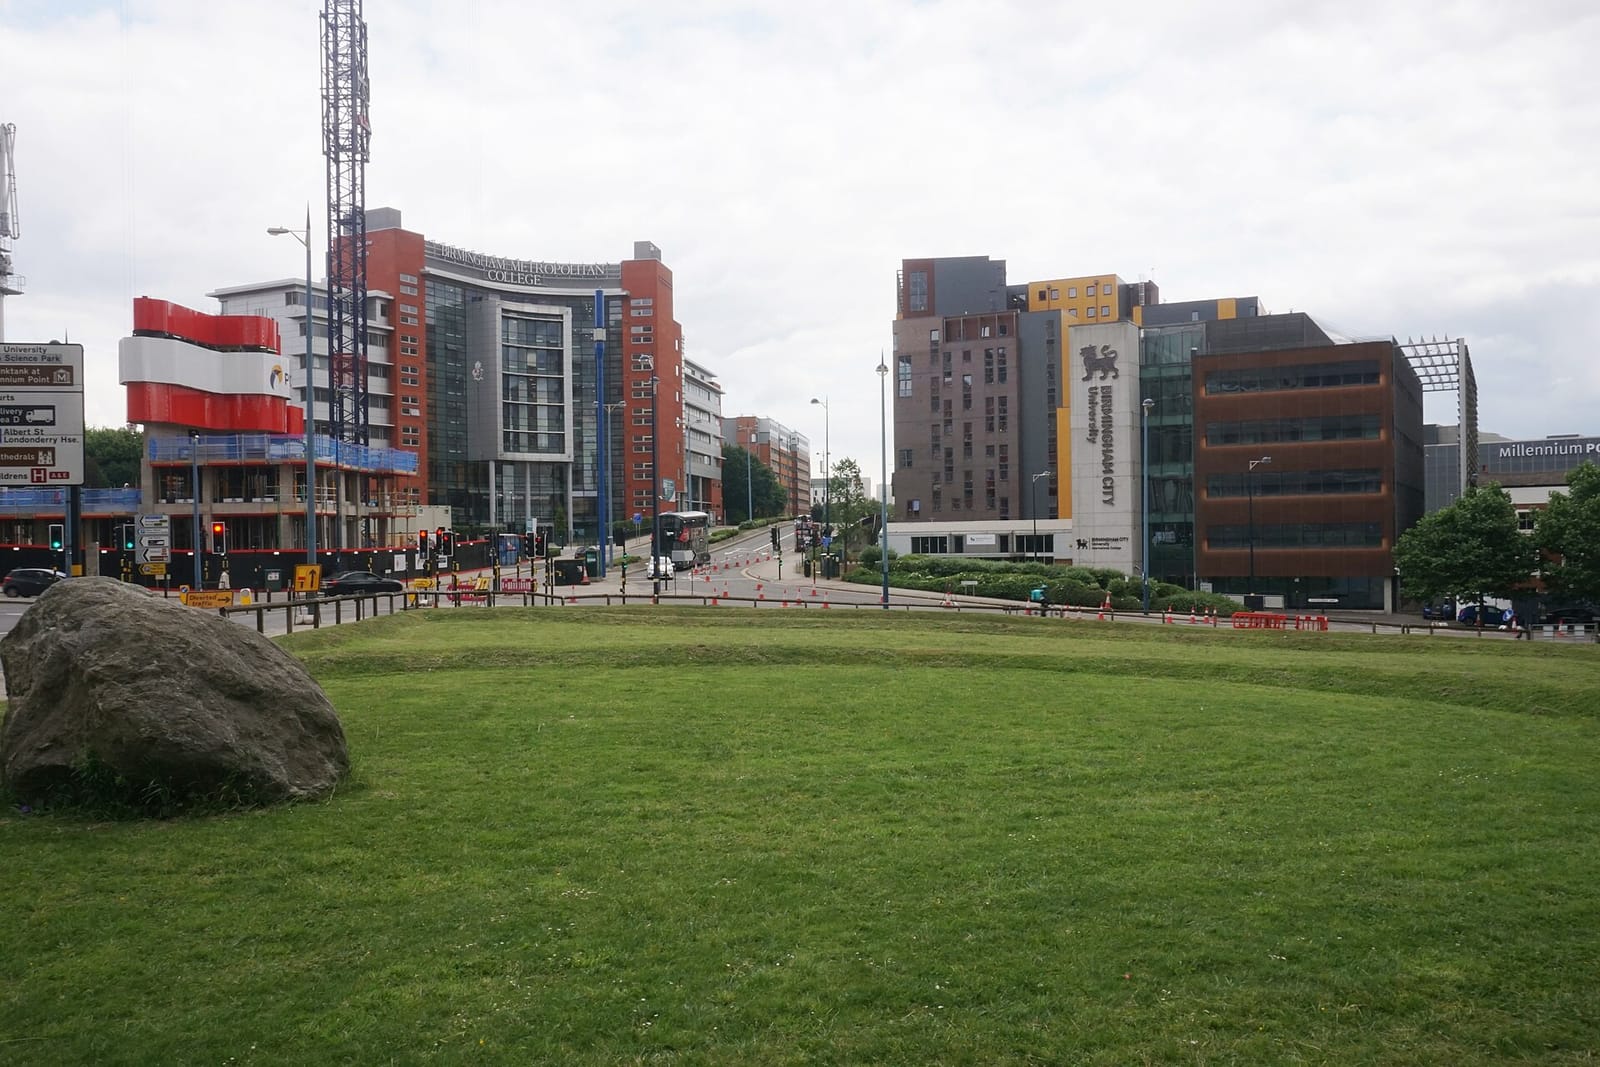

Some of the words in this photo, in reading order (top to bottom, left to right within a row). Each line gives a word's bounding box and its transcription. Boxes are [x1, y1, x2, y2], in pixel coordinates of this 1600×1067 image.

[441, 245, 506, 269] BIRMINGHAM
[510, 260, 605, 275] METROPOLITAN
[487, 270, 543, 286] COLLEGE
[4, 345, 48, 354] University
[4, 354, 38, 362] Science
[41, 354, 61, 362] Park
[31, 367, 41, 375] at
[27, 375, 50, 383] Point
[1086, 386, 1098, 444] University
[4, 428, 31, 436] Albert
[34, 428, 45, 436] St
[1101, 385, 1114, 474] BIRMINGHAM
[4, 436, 57, 445] Londonderry
[60, 436, 80, 444] Hse.
[1500, 442, 1583, 457] Millennium
[33, 470, 45, 482] H
[1102, 477, 1115, 507] CITY
